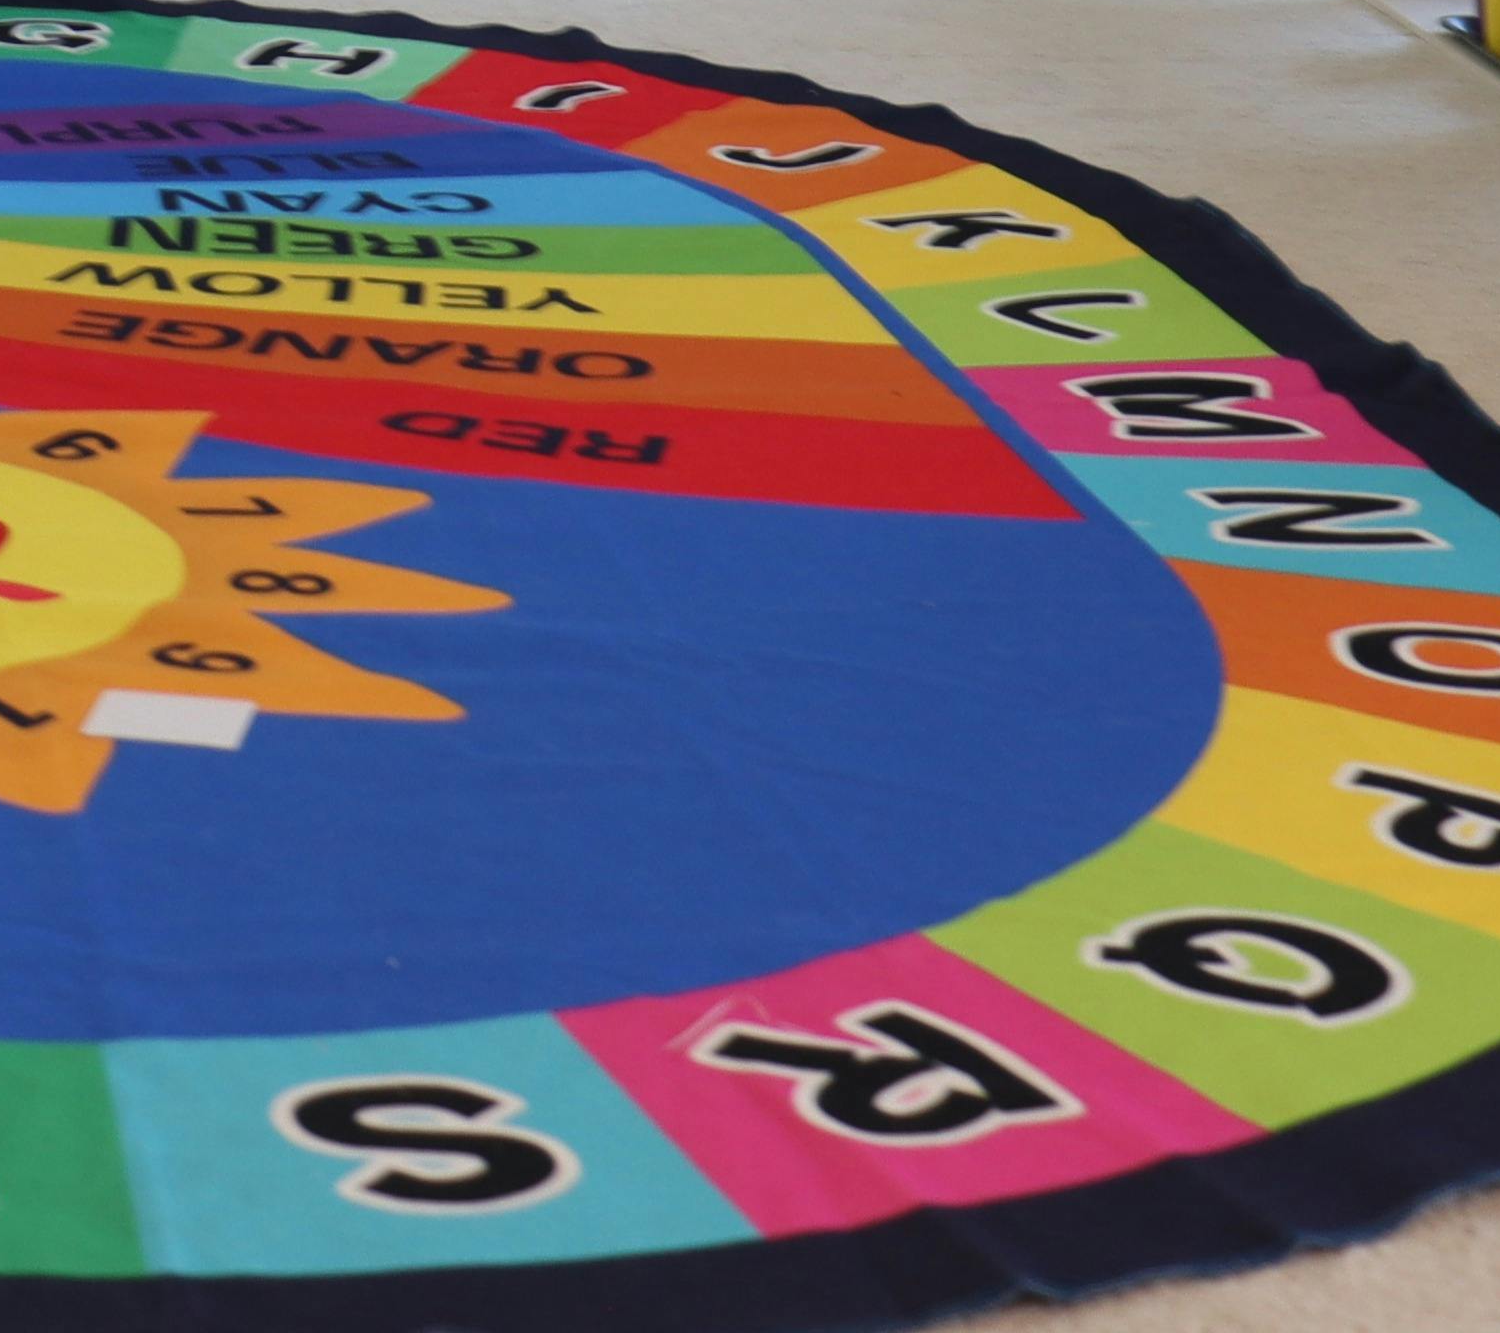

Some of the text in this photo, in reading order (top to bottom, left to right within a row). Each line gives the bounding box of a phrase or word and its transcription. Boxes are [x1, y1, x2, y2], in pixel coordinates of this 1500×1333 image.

[237, 37, 395, 77] H
[130, 152, 421, 177] BLUE
[708, 140, 882, 172] J
[159, 186, 495, 215] CYAN
[110, 215, 543, 262] GREEN
[860, 208, 1073, 253] K
[47, 259, 604, 315] YELLOW
[984, 289, 1147, 345] L
[60, 308, 654, 382] ORANGE
[1065, 372, 1323, 443] M
[32, 430, 120, 461] 6
[381, 409, 673, 466] RED
[179, 495, 285, 520] 7
[1184, 488, 1453, 550] N
[228, 569, 334, 596] 8
[148, 642, 258, 674] 9
[1080, 906, 1414, 1028] Q
[692, 1002, 1086, 1147] R
[268, 1072, 581, 1215] S
